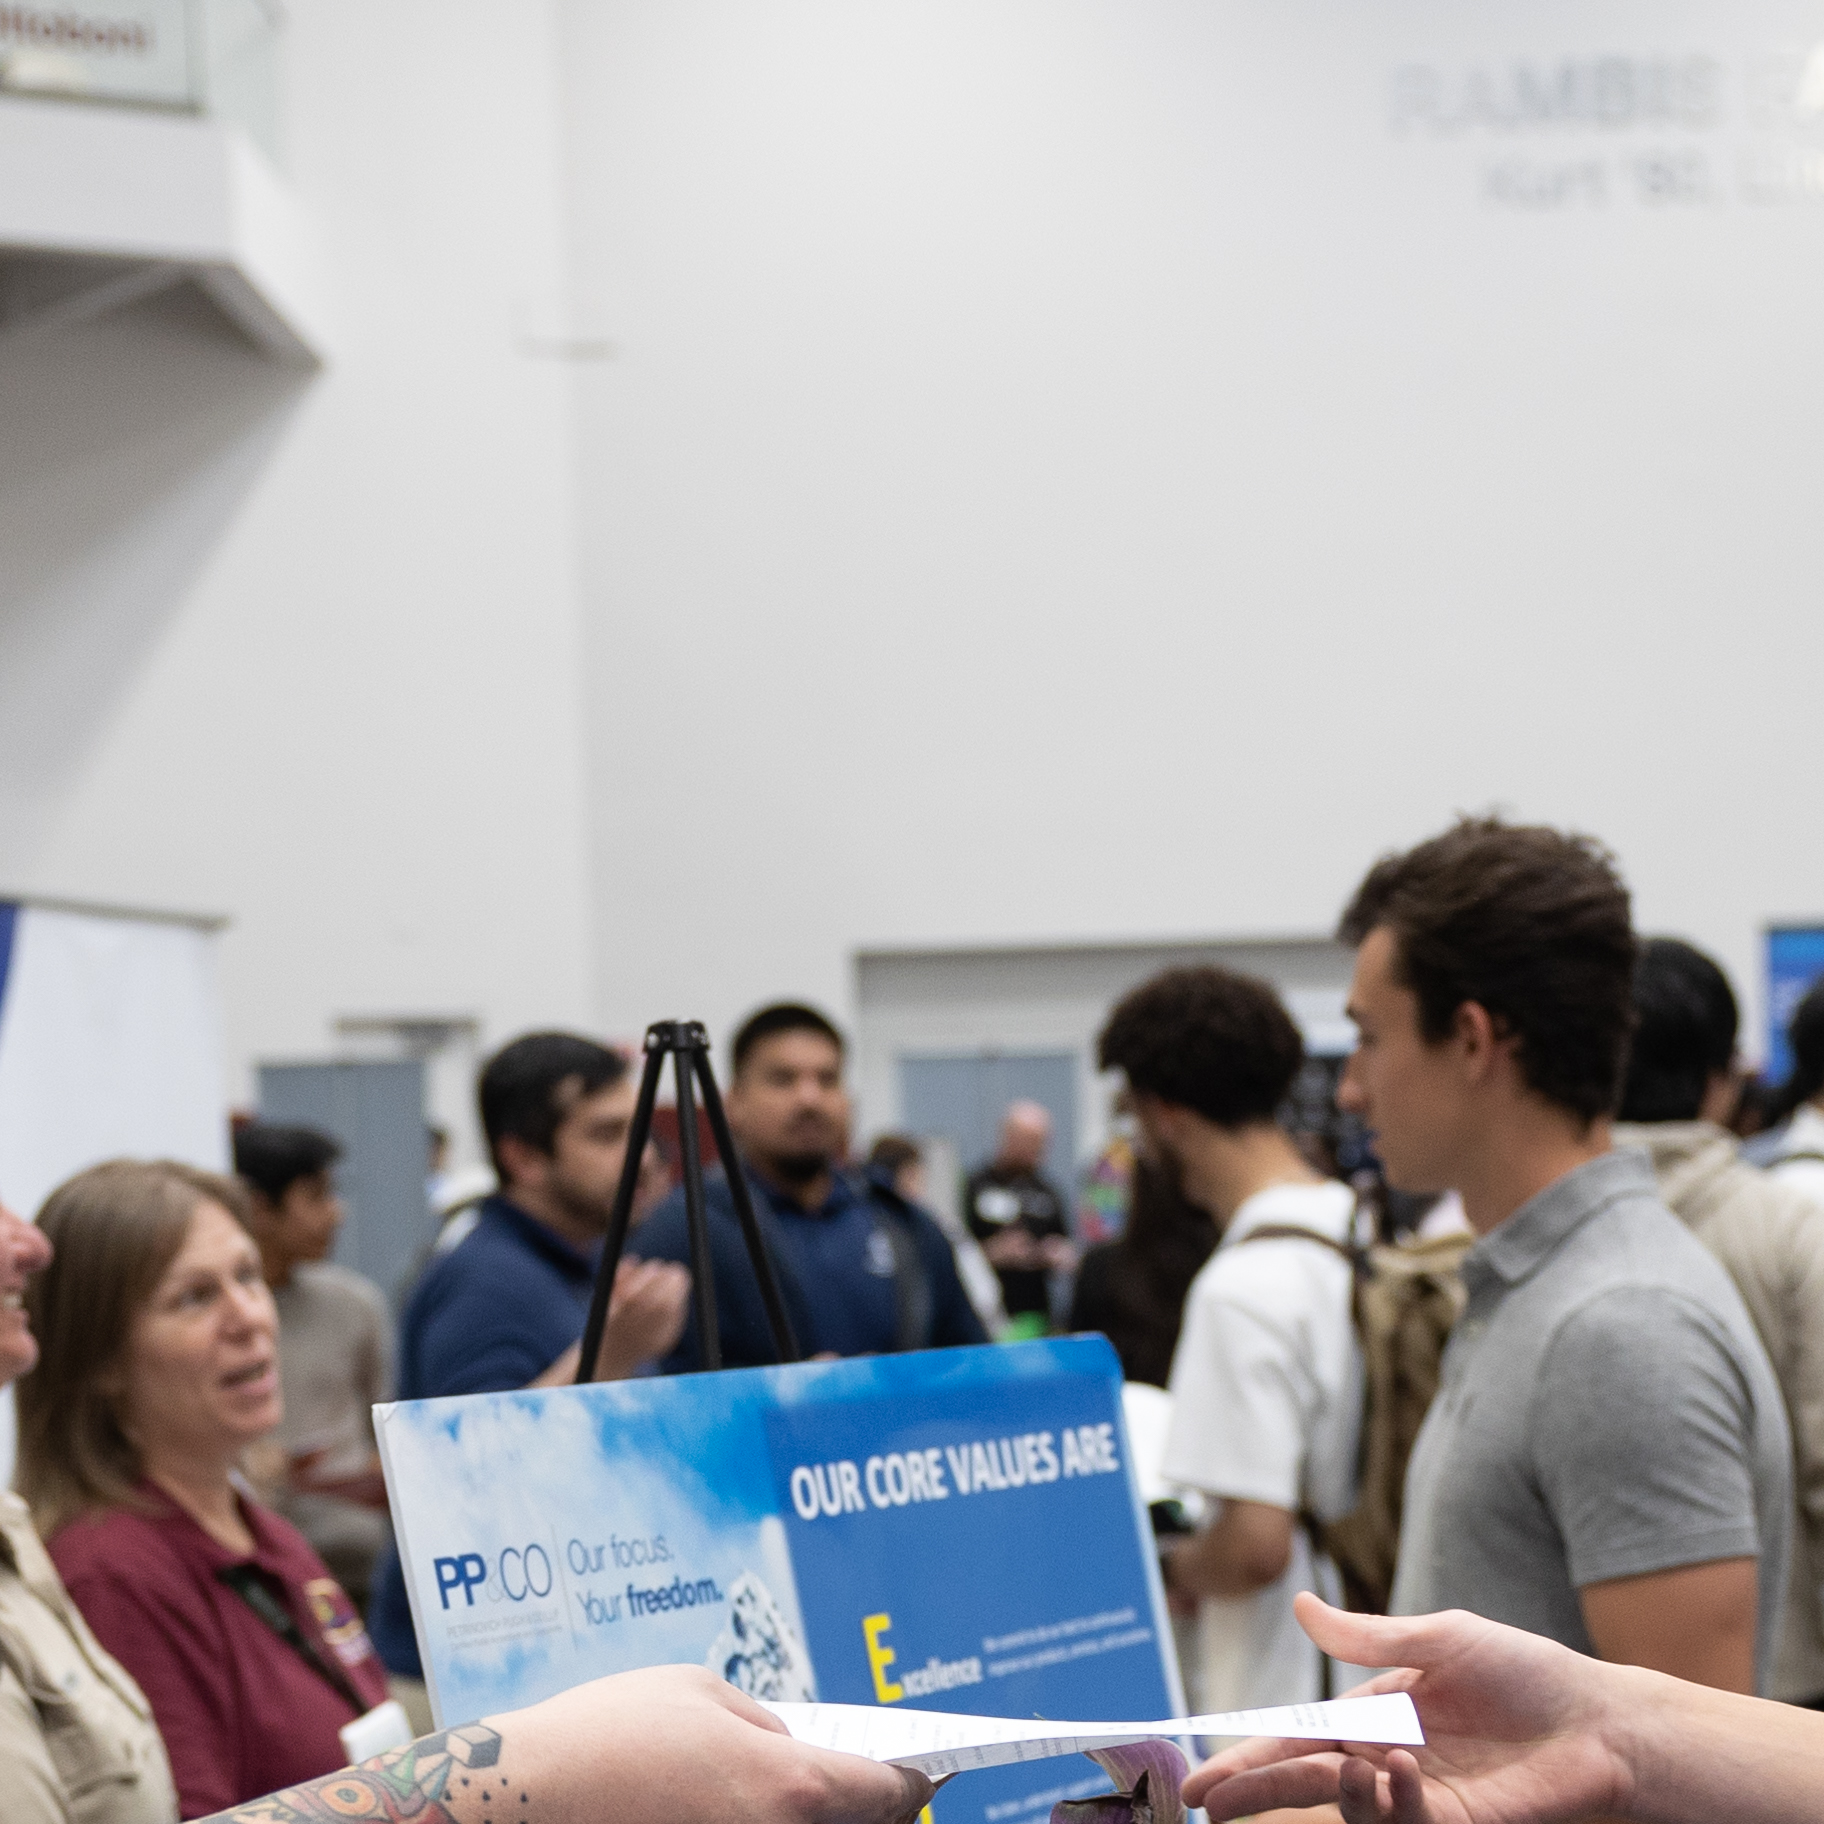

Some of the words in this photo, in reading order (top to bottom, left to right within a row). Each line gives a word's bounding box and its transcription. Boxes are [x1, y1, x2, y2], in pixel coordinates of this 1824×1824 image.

[789, 1462, 866, 1522] OUR
[867, 1449, 951, 1512] CORE
[949, 1434, 1062, 1497] VALUES
[1061, 1422, 1121, 1479] ARE
[432, 1542, 553, 1611] PP&CO
[567, 1538, 606, 1576] Our
[610, 1533, 676, 1571] focus.
[576, 1590, 624, 1626] Your
[626, 1576, 726, 1618] freedom.
